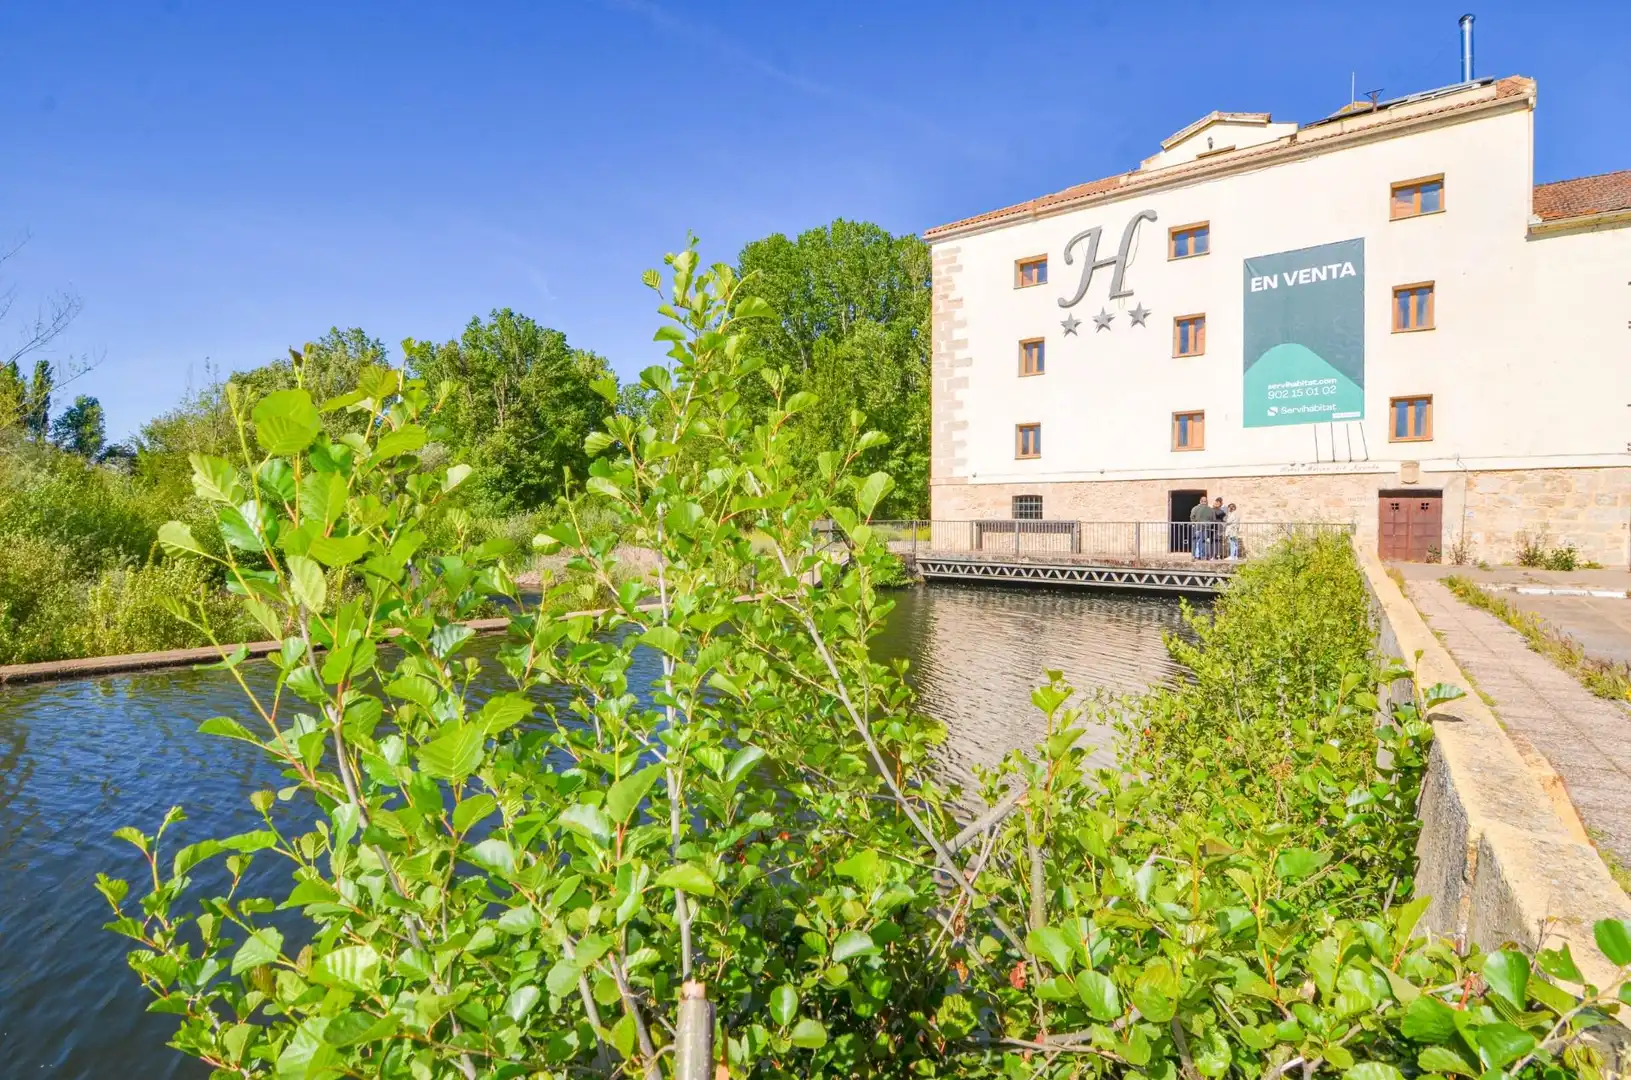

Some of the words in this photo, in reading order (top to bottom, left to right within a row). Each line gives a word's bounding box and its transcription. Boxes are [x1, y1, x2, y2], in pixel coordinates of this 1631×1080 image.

[1057, 209, 1158, 308] H
[1251, 274, 1278, 292] EN
[1283, 261, 1356, 286] VENTA
[1267, 378, 1337, 389] servihabitat.com
[1267, 389, 1289, 399] 902
[1291, 388, 1304, 397] 15
[1306, 387, 1319, 396] 01
[1322, 385, 1337, 394] 02
[1281, 403, 1337, 414] Servihabitat
